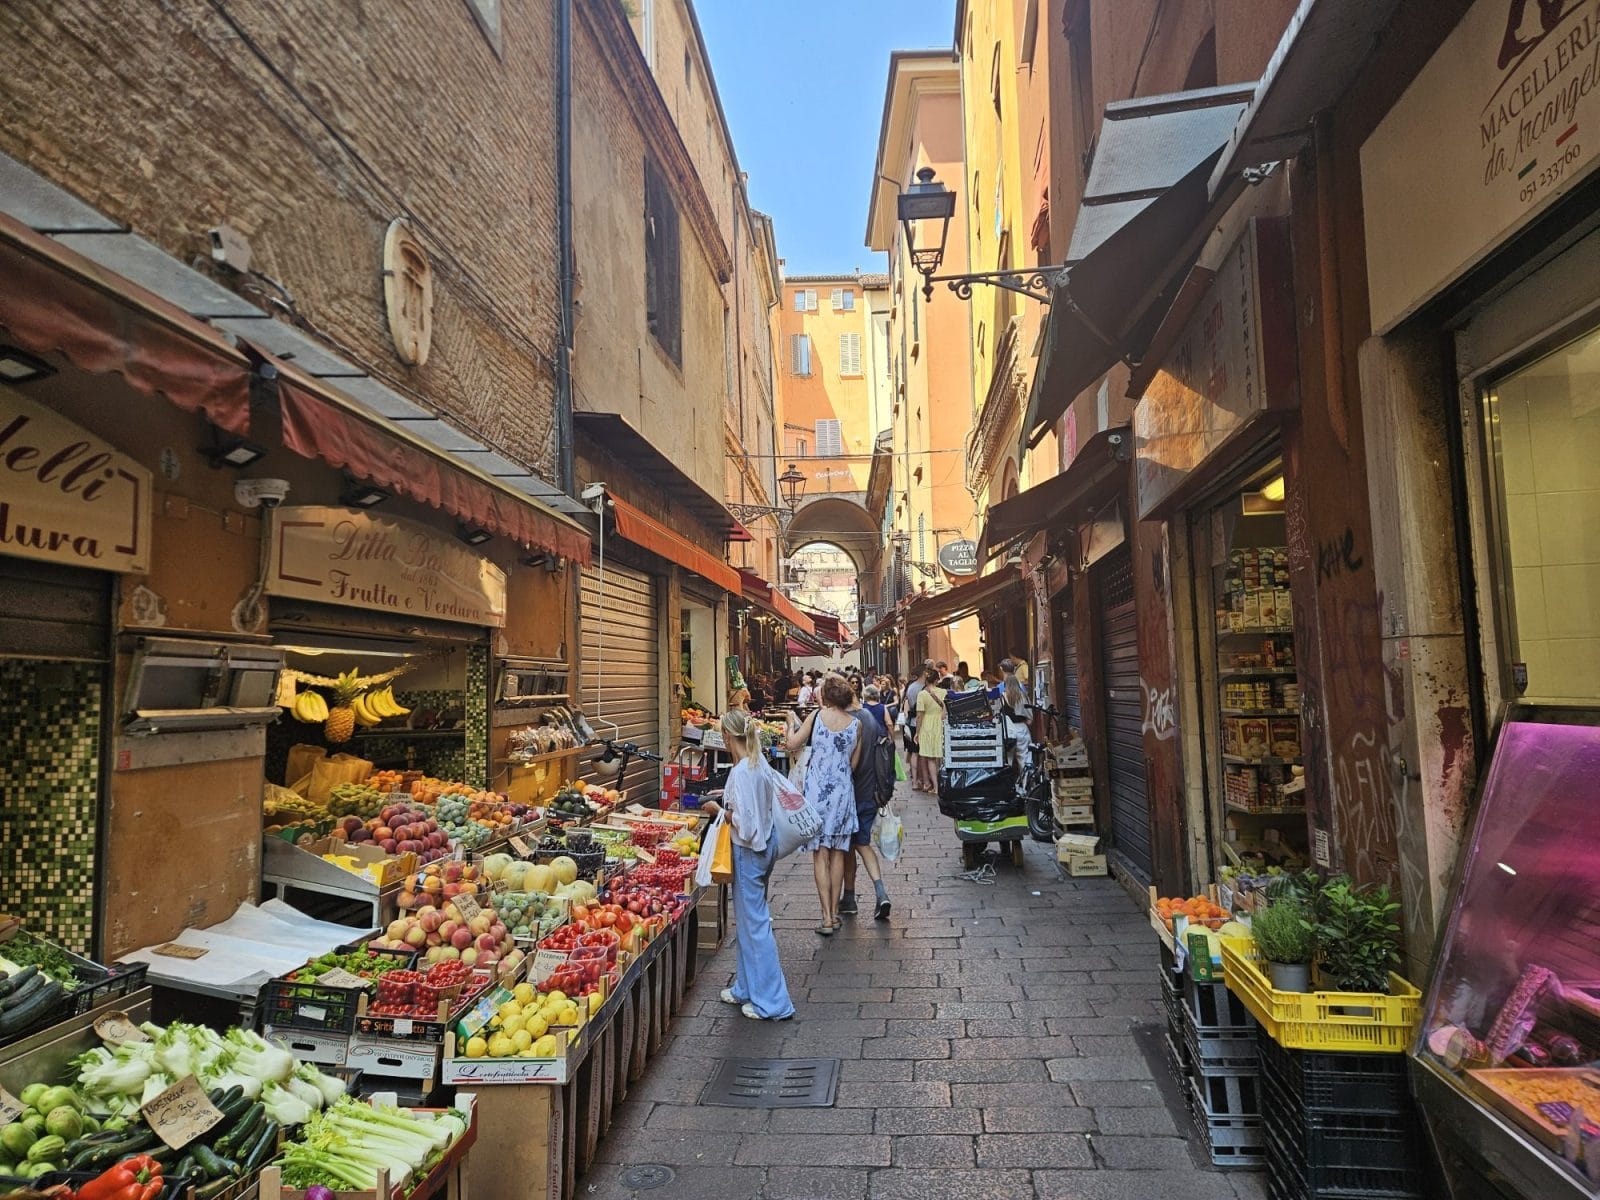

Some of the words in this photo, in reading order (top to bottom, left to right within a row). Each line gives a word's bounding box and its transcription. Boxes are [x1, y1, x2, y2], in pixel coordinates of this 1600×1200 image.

[1484, 142, 1507, 187] da
[1508, 41, 1600, 173] Arcangel
[1520, 180, 1538, 203] 051
[1540, 143, 1581, 188] 233760
[328, 520, 396, 561] Ditta
[951, 544, 975, 552] PIZZA
[958, 551, 969, 559] AL
[948, 558, 978, 566] TAGLIO
[328, 569, 400, 608] Frutta
[405, 596, 414, 609] e
[417, 586, 481, 620] Verdura
